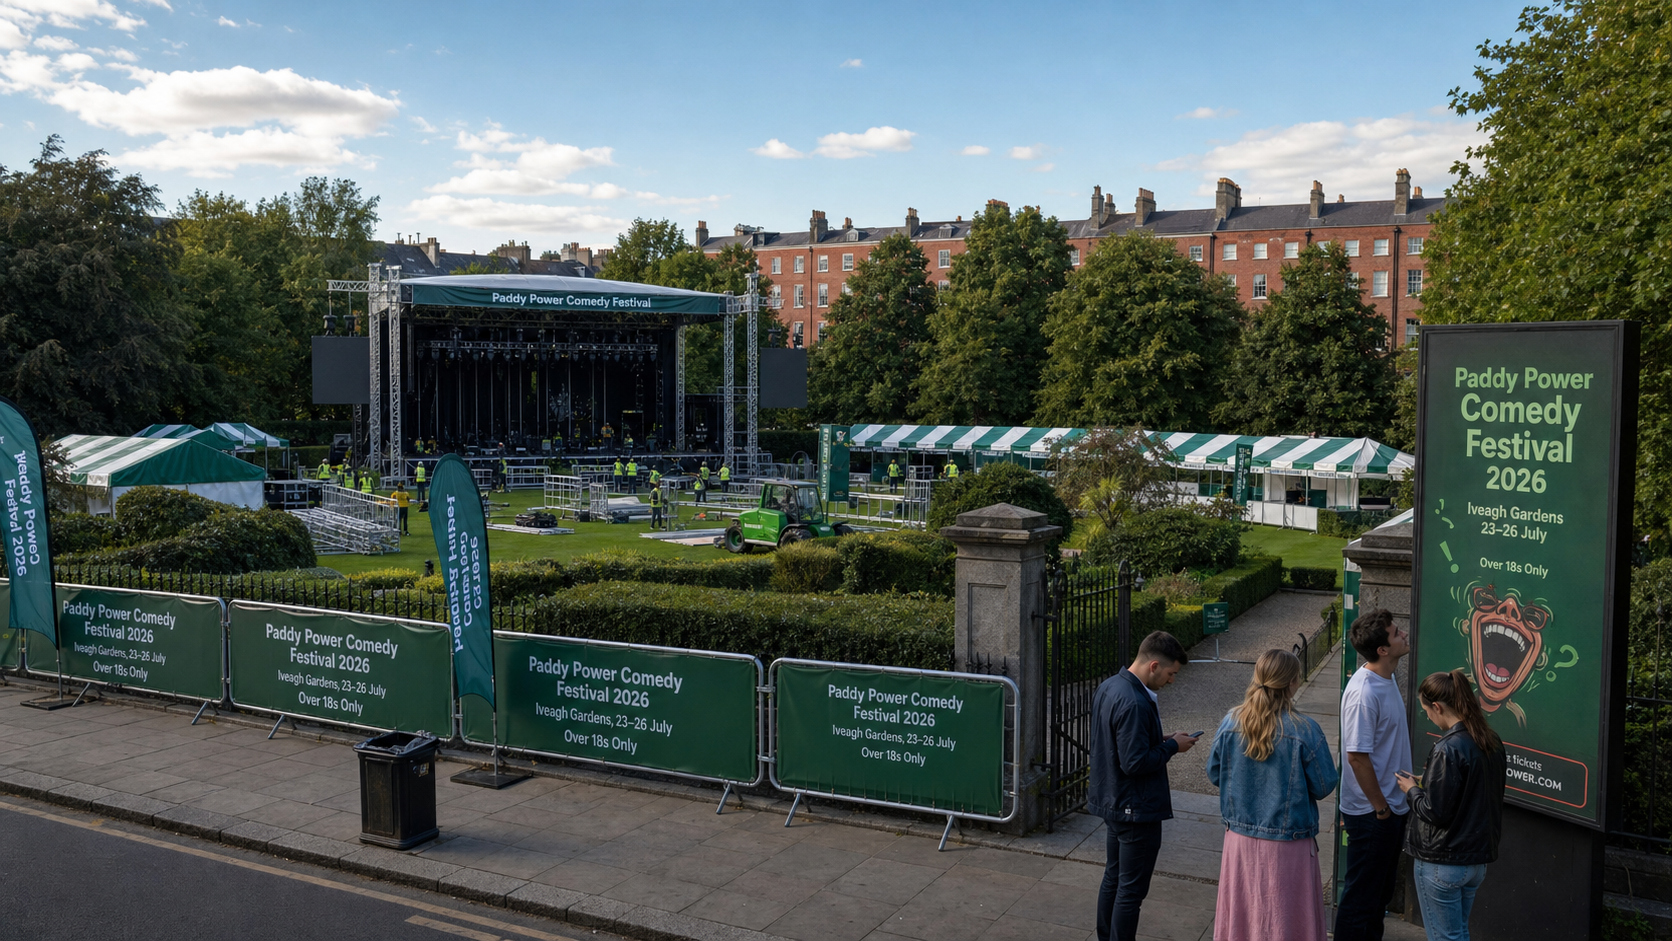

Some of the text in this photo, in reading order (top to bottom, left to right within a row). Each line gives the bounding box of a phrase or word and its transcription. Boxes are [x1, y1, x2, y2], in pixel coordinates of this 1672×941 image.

[493, 293, 651, 308] Paddy Power Comedy Festival
[1455, 367, 1593, 393] Paddy Power
[1461, 393, 1582, 432] Comedy
[1466, 429, 1573, 463] Festival
[1486, 466, 1547, 493] 2026
[1468, 502, 1564, 524] Iveagh Gardens
[1521, 526, 1547, 544] July
[13, 535, 27, 577] 2026
[1480, 557, 1548, 579] Over 18s Only
[63, 600, 176, 630] Paddy Power Comedy
[85, 621, 154, 643] Festival 2026
[266, 623, 398, 659] Paddy Power Comedy
[75, 642, 97, 656] Iveagh
[98, 645, 128, 659] Gardens,
[151, 652, 166, 666] July
[290, 647, 370, 673] Festival 2026
[93, 661, 148, 682] Over 18s Only
[278, 670, 304, 686] Iveagh
[306, 674, 340, 691] Gardens,
[368, 684, 386, 699] July
[530, 656, 683, 694] Paddy Power Comedy
[299, 691, 363, 717] Over 18s Only
[557, 681, 649, 708] Festival 2026
[828, 684, 963, 713] Paddy Power Comedy
[536, 702, 568, 721] Iveagh
[570, 708, 614, 728] Gardens,
[650, 719, 673, 737] July
[854, 705, 935, 727] Festival 2026
[564, 729, 637, 755] Over 18s Only
[833, 724, 863, 740] Iveagh
[865, 728, 905, 744] Gardens,
[936, 736, 956, 751] July
[861, 747, 926, 767] Over 18s Only
[1513, 755, 1542, 771] tickets
[1506, 768, 1561, 791] OWER.COM
